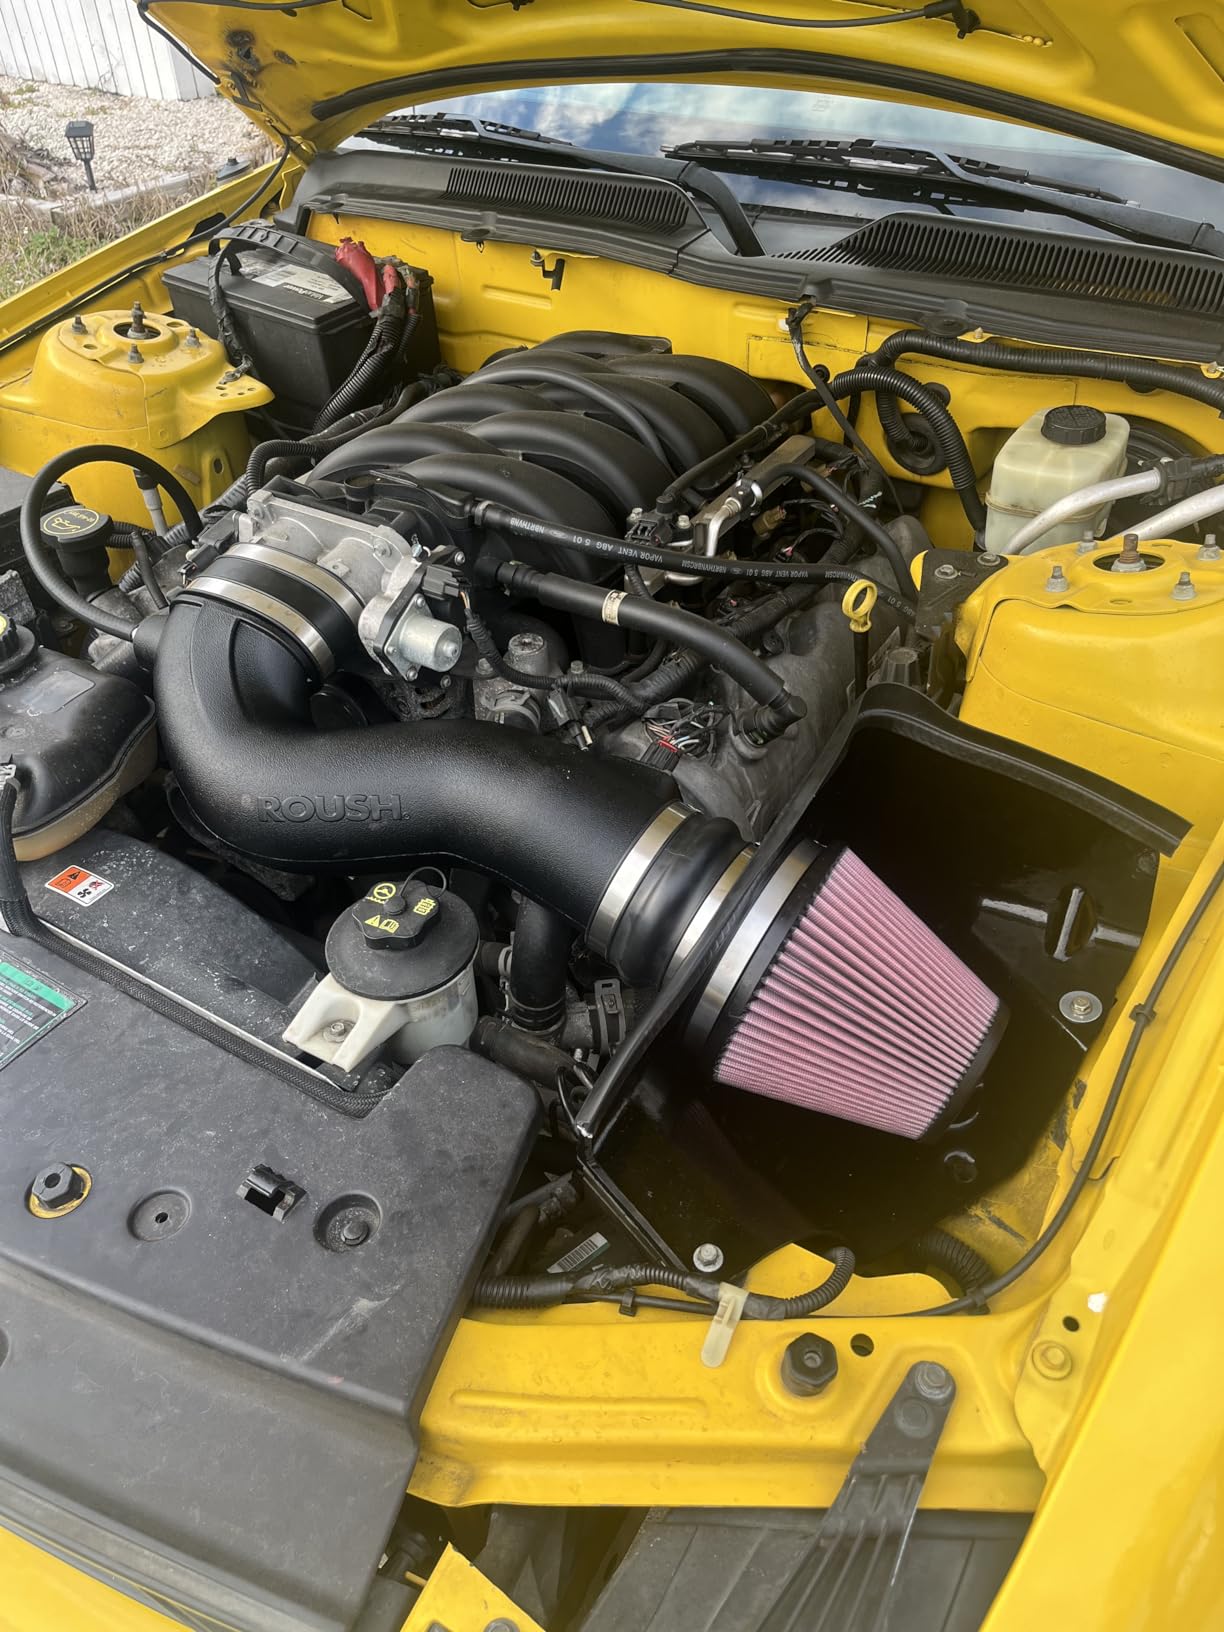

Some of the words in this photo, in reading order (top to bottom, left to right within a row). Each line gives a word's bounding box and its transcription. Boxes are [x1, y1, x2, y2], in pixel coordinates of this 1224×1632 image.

[572, 535, 582, 545] 01
[584, 538, 591, 546] 5
[596, 541, 613, 551] ABG
[618, 546, 638, 557] VENT
[639, 551, 663, 563] VAPOR
[256, 793, 403, 823] ROUSH
